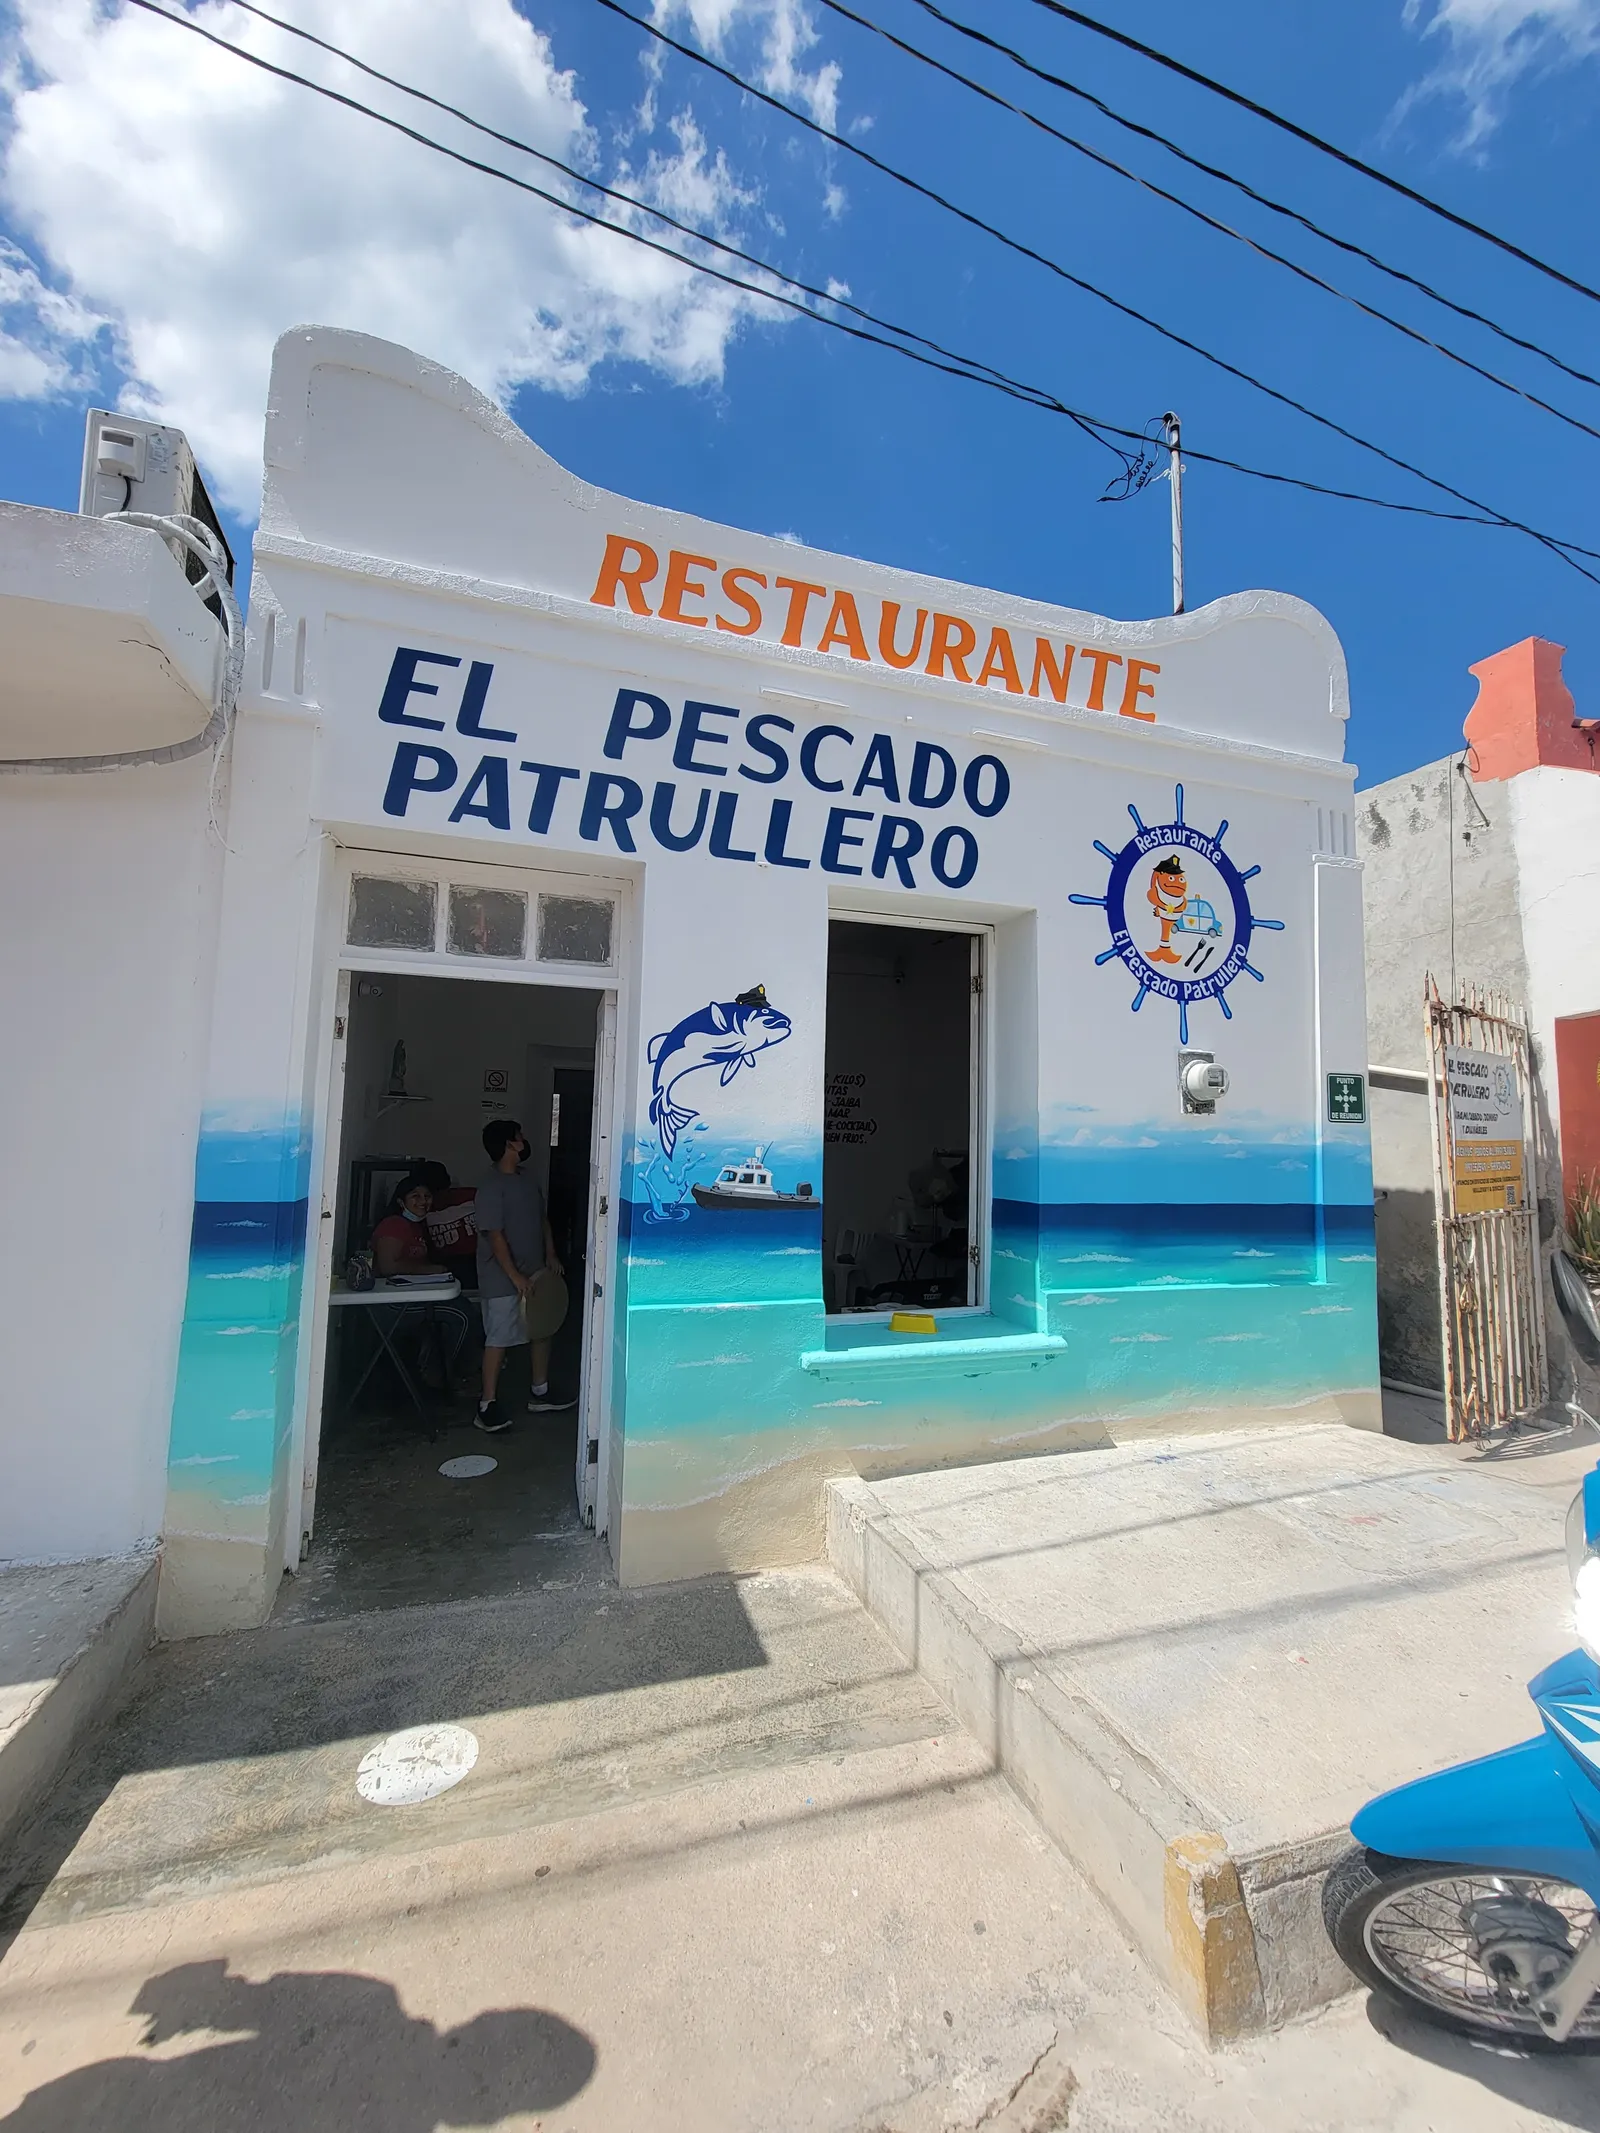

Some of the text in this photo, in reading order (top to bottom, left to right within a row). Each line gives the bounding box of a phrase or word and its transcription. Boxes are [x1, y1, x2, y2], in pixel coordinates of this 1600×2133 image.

[591, 535, 1160, 721] RESTAURANTE
[378, 647, 1010, 817] EL PESCADO
[383, 742, 978, 888] PATRULLERO
[1134, 826, 1222, 864] Restaurante
[1114, 928, 1247, 1000] El Pescado Patrullero
[1336, 1077, 1355, 1085] PUNTO
